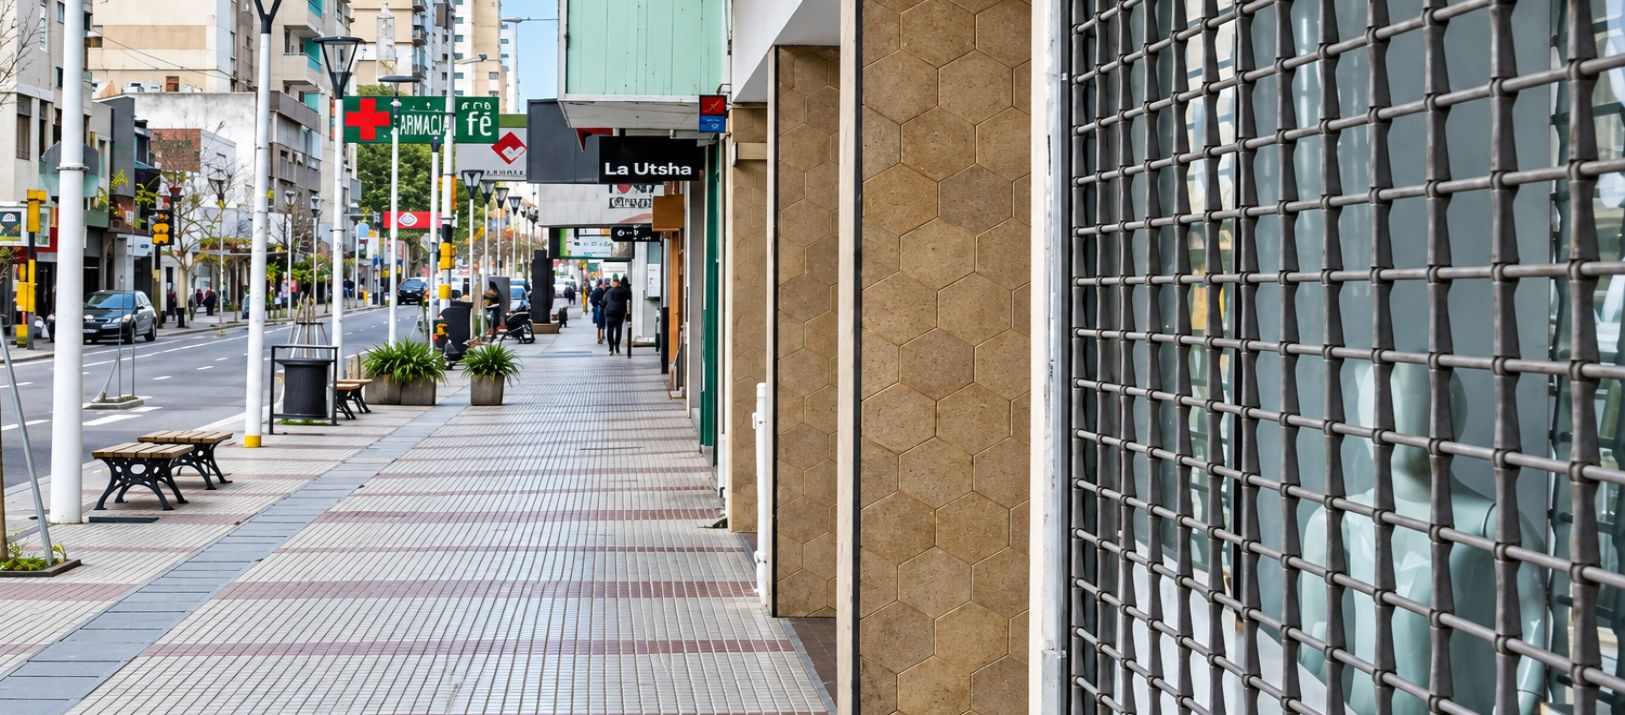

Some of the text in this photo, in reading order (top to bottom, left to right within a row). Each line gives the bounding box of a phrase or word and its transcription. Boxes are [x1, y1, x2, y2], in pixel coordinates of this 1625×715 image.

[399, 114, 456, 136] ARMACIA
[604, 162, 692, 176] La Utsha
